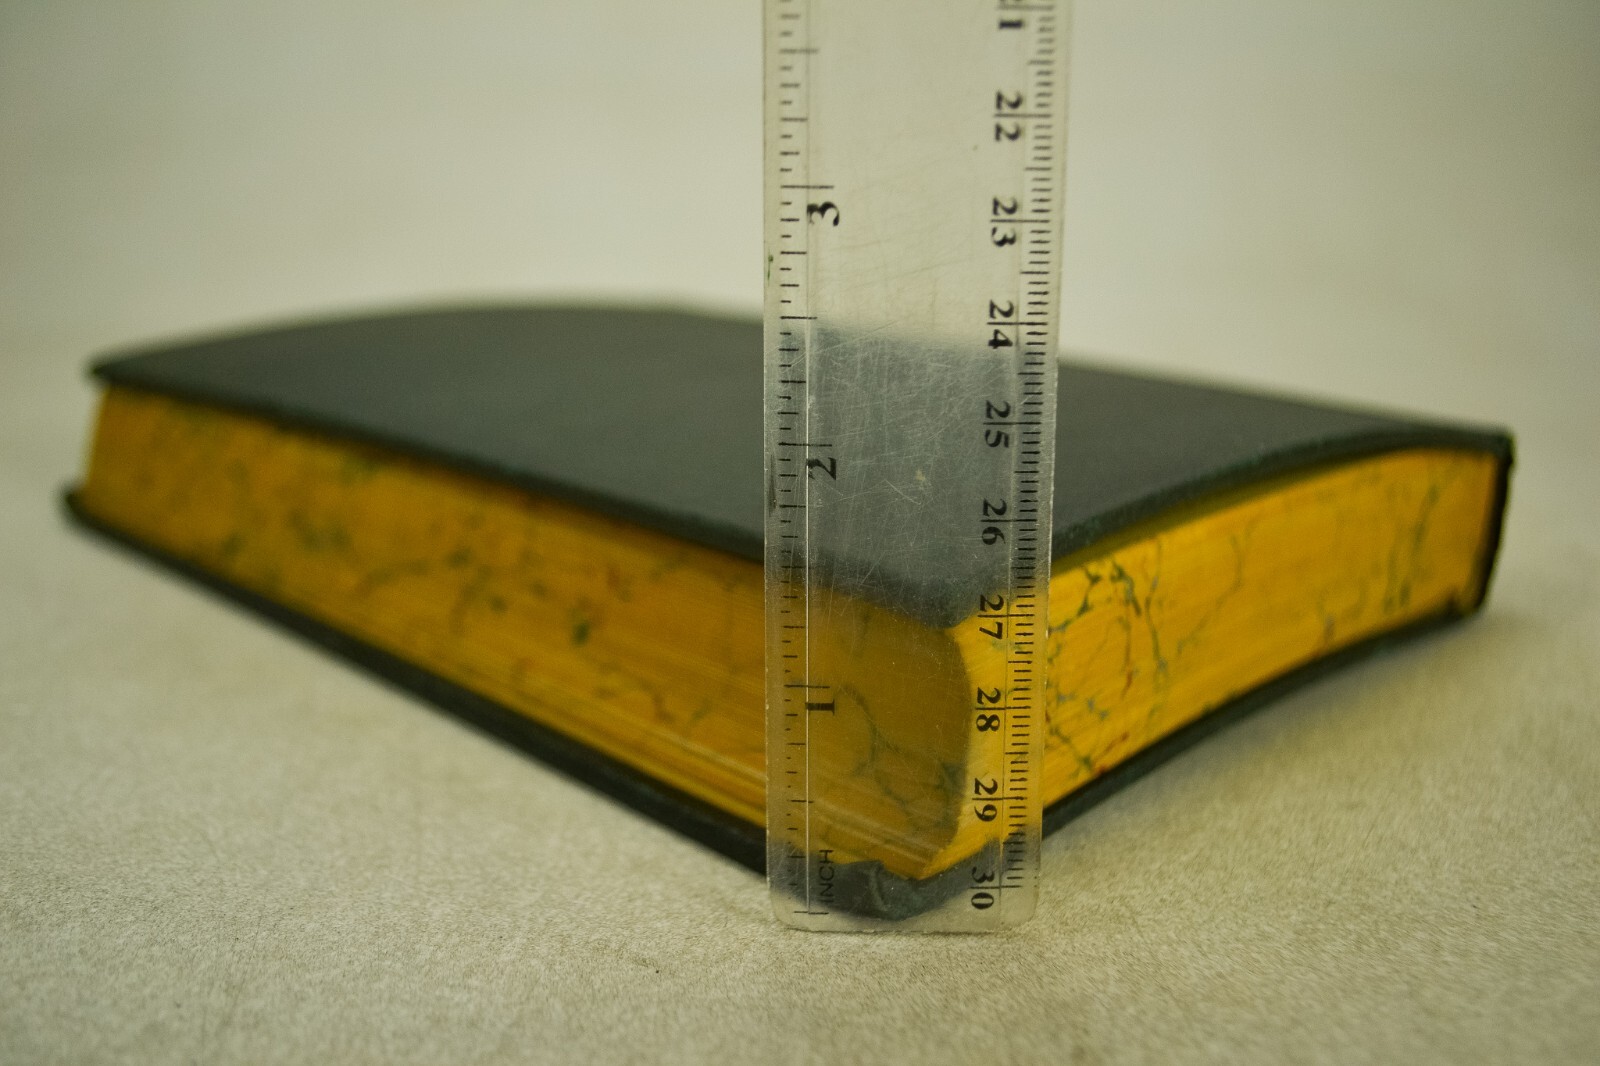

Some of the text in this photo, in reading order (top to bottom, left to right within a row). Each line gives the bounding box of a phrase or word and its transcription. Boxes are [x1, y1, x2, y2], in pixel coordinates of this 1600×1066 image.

[806, 201, 840, 227] 3
[991, 197, 1018, 247] 23
[987, 299, 1015, 349] 24
[984, 400, 1011, 448] 25
[806, 457, 837, 480] 2
[981, 498, 1007, 545] 26
[979, 594, 1004, 640] 27
[805, 699, 835, 716] 1
[976, 686, 1001, 732] 28
[974, 777, 998, 822] 29
[819, 849, 835, 903] INCH
[971, 866, 995, 910] 30
